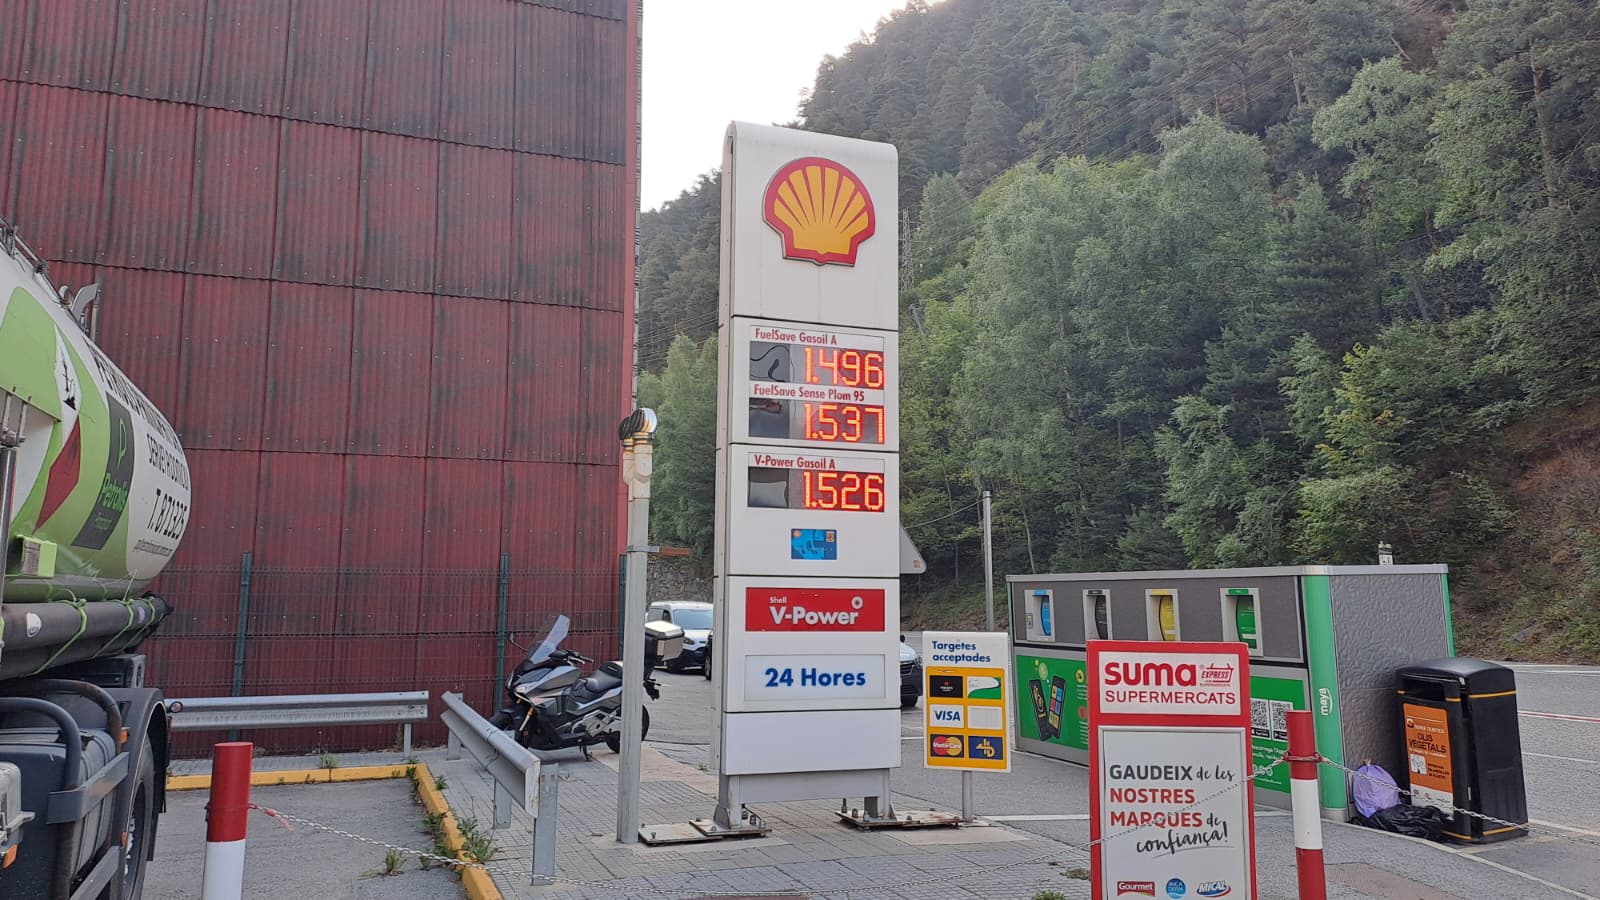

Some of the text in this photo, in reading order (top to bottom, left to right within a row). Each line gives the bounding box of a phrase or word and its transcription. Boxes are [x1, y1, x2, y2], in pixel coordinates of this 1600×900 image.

[755, 328, 837, 345] FuelSave Gasoil A
[804, 346, 884, 389] 1.496
[754, 384, 865, 401] FuelSave Sense Plom 95
[804, 402, 885, 444] 1.537
[754, 455, 836, 470] V-Power Gasoil A
[804, 470, 884, 512] 1.526
[769, 596, 787, 604] Shell
[769, 606, 859, 625] V-Power
[932, 641, 976, 652] Targetes
[932, 653, 991, 664] acceptades
[765, 668, 866, 687] 24 Hores
[1201, 670, 1230, 679] EXPRESS
[1105, 690, 1236, 704] SUPERMERCATS
[1319, 688, 1329, 716] maya
[934, 710, 961, 721] VISA
[1109, 764, 1193, 781] GAUDEIX
[1196, 766, 1211, 781] de
[1215, 765, 1235, 781] les
[1110, 788, 1196, 804] NOSTRES
[1110, 811, 1221, 829] MARQUES de
[1136, 821, 1228, 854] confiança!
[1118, 882, 1153, 891] Gourmet
